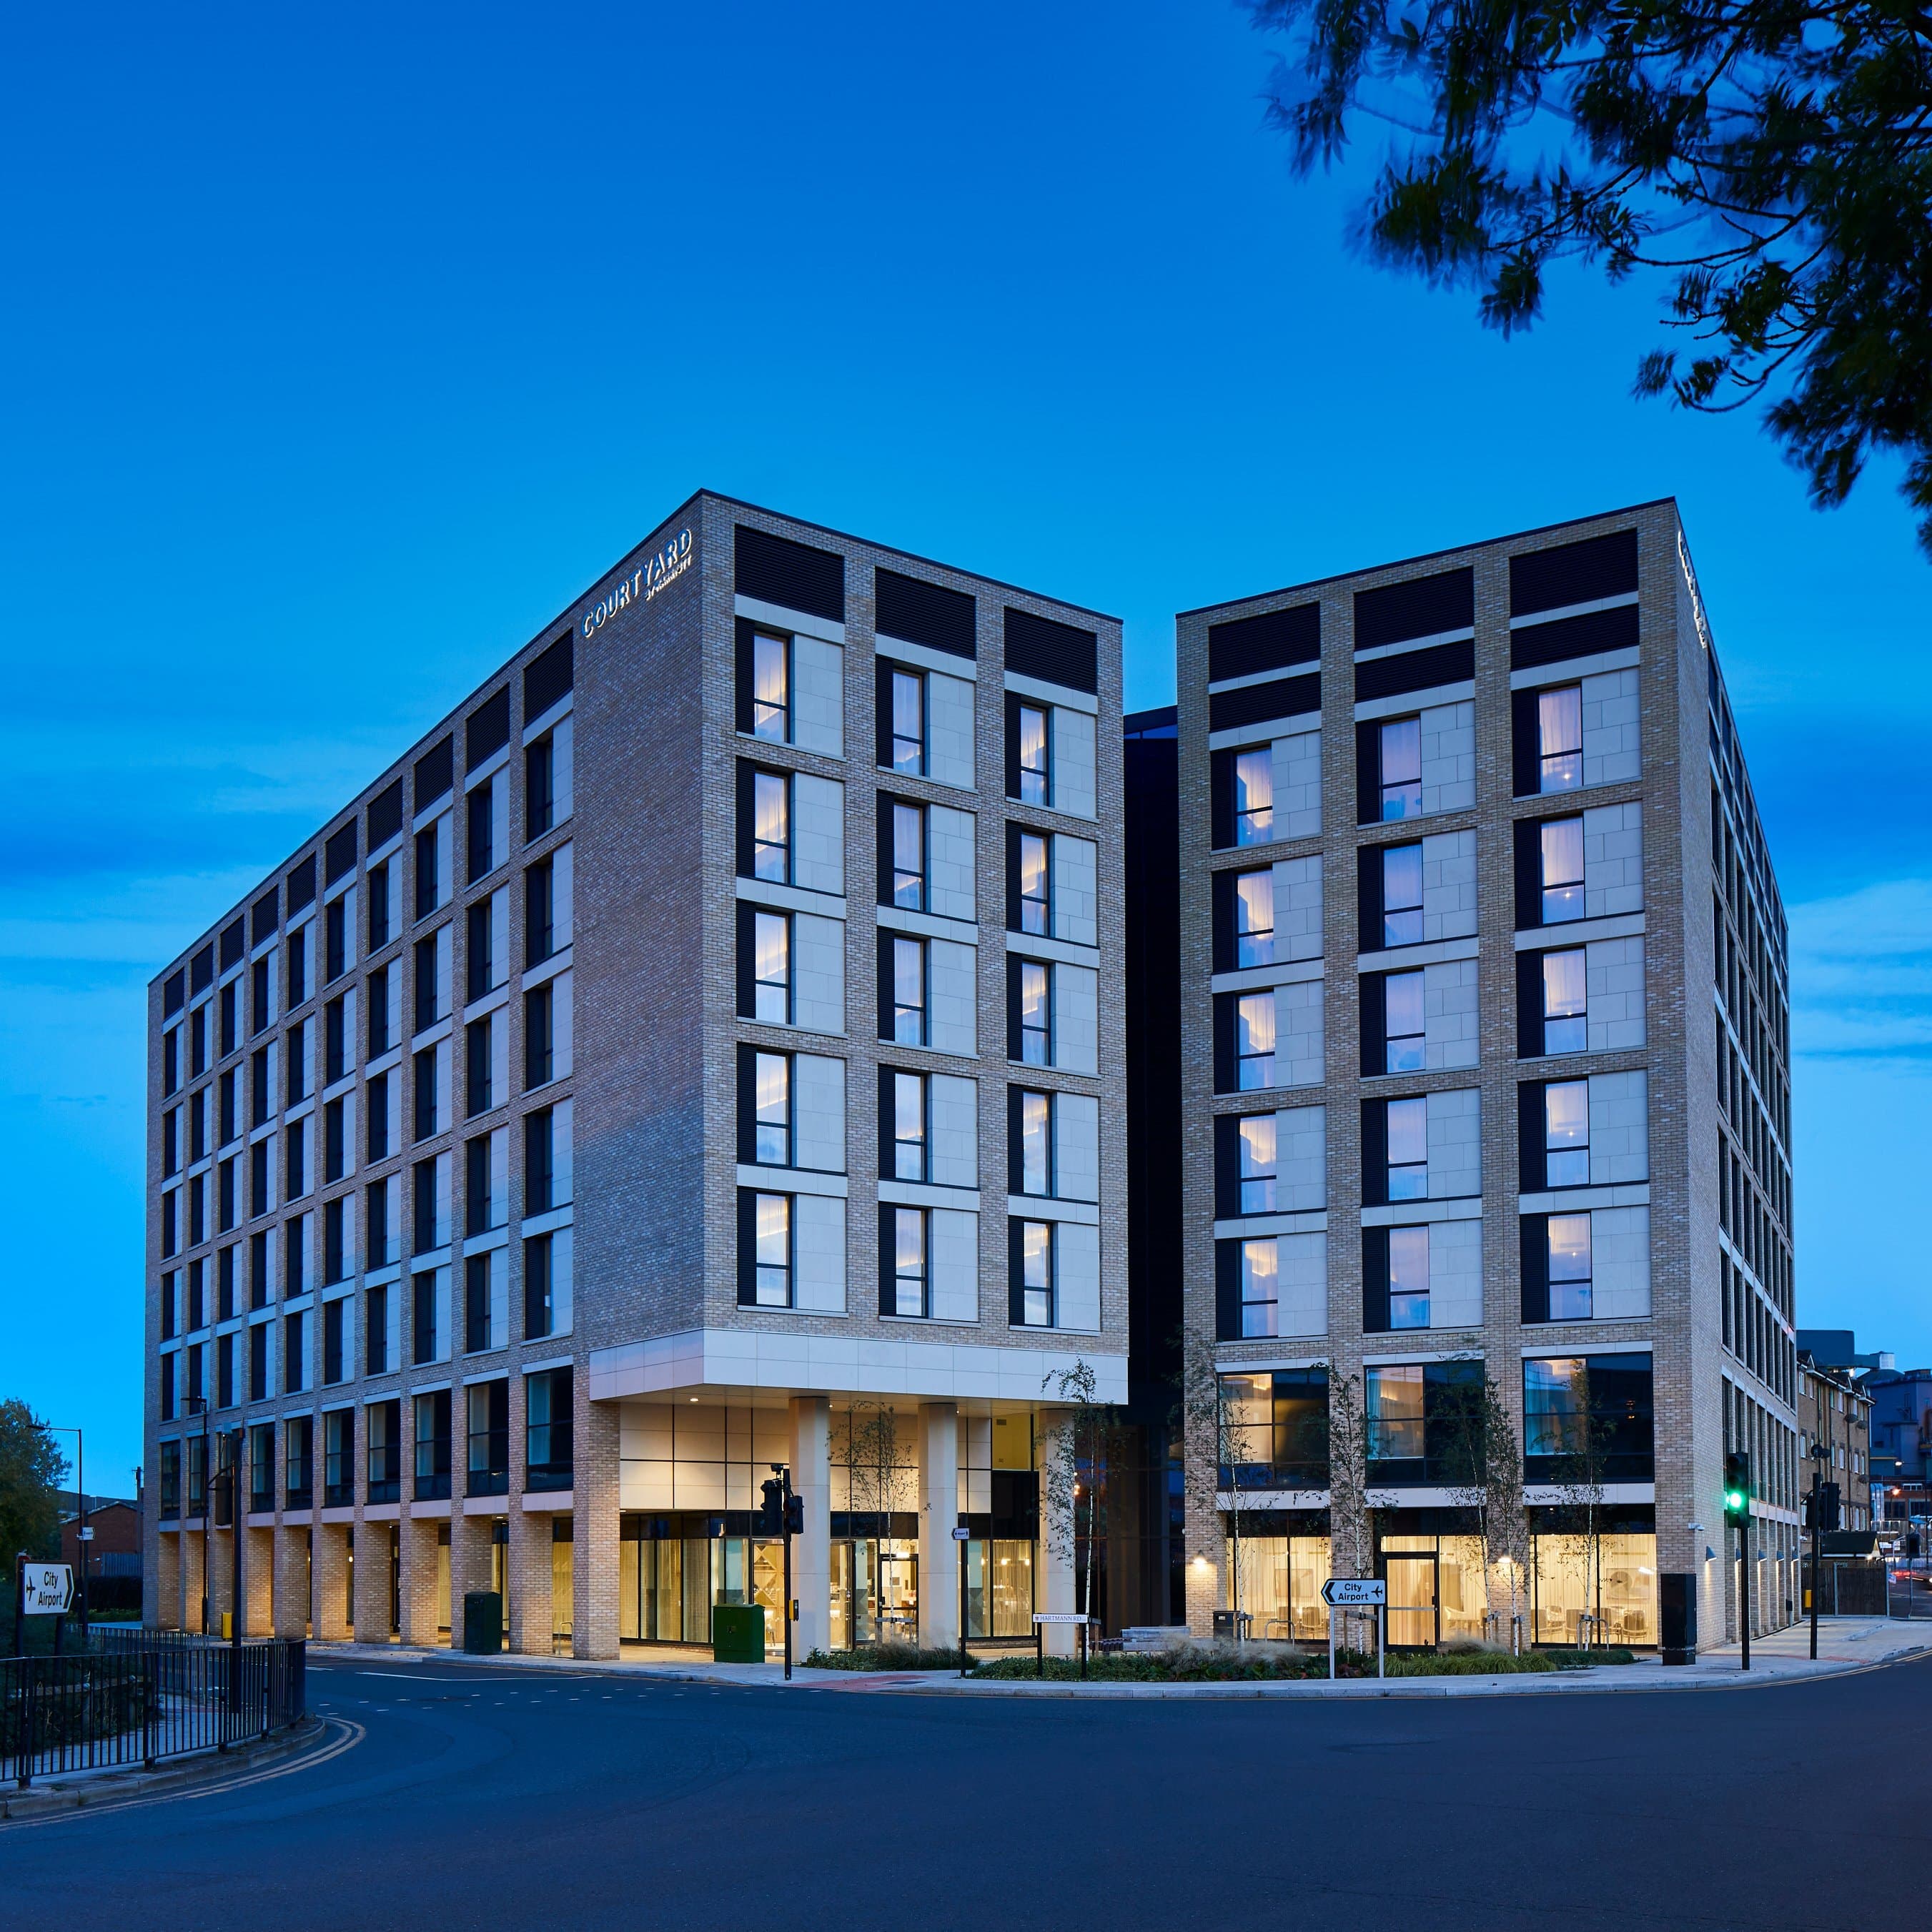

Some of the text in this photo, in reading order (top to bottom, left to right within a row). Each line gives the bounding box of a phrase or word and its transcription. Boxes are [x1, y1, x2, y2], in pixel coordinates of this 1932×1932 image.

[581, 529, 692, 638] COURTYARD
[44, 1571, 59, 1589] City
[1344, 1583, 1362, 1592] City
[37, 1591, 62, 1609] Airport
[1338, 1592, 1369, 1602] Airport
